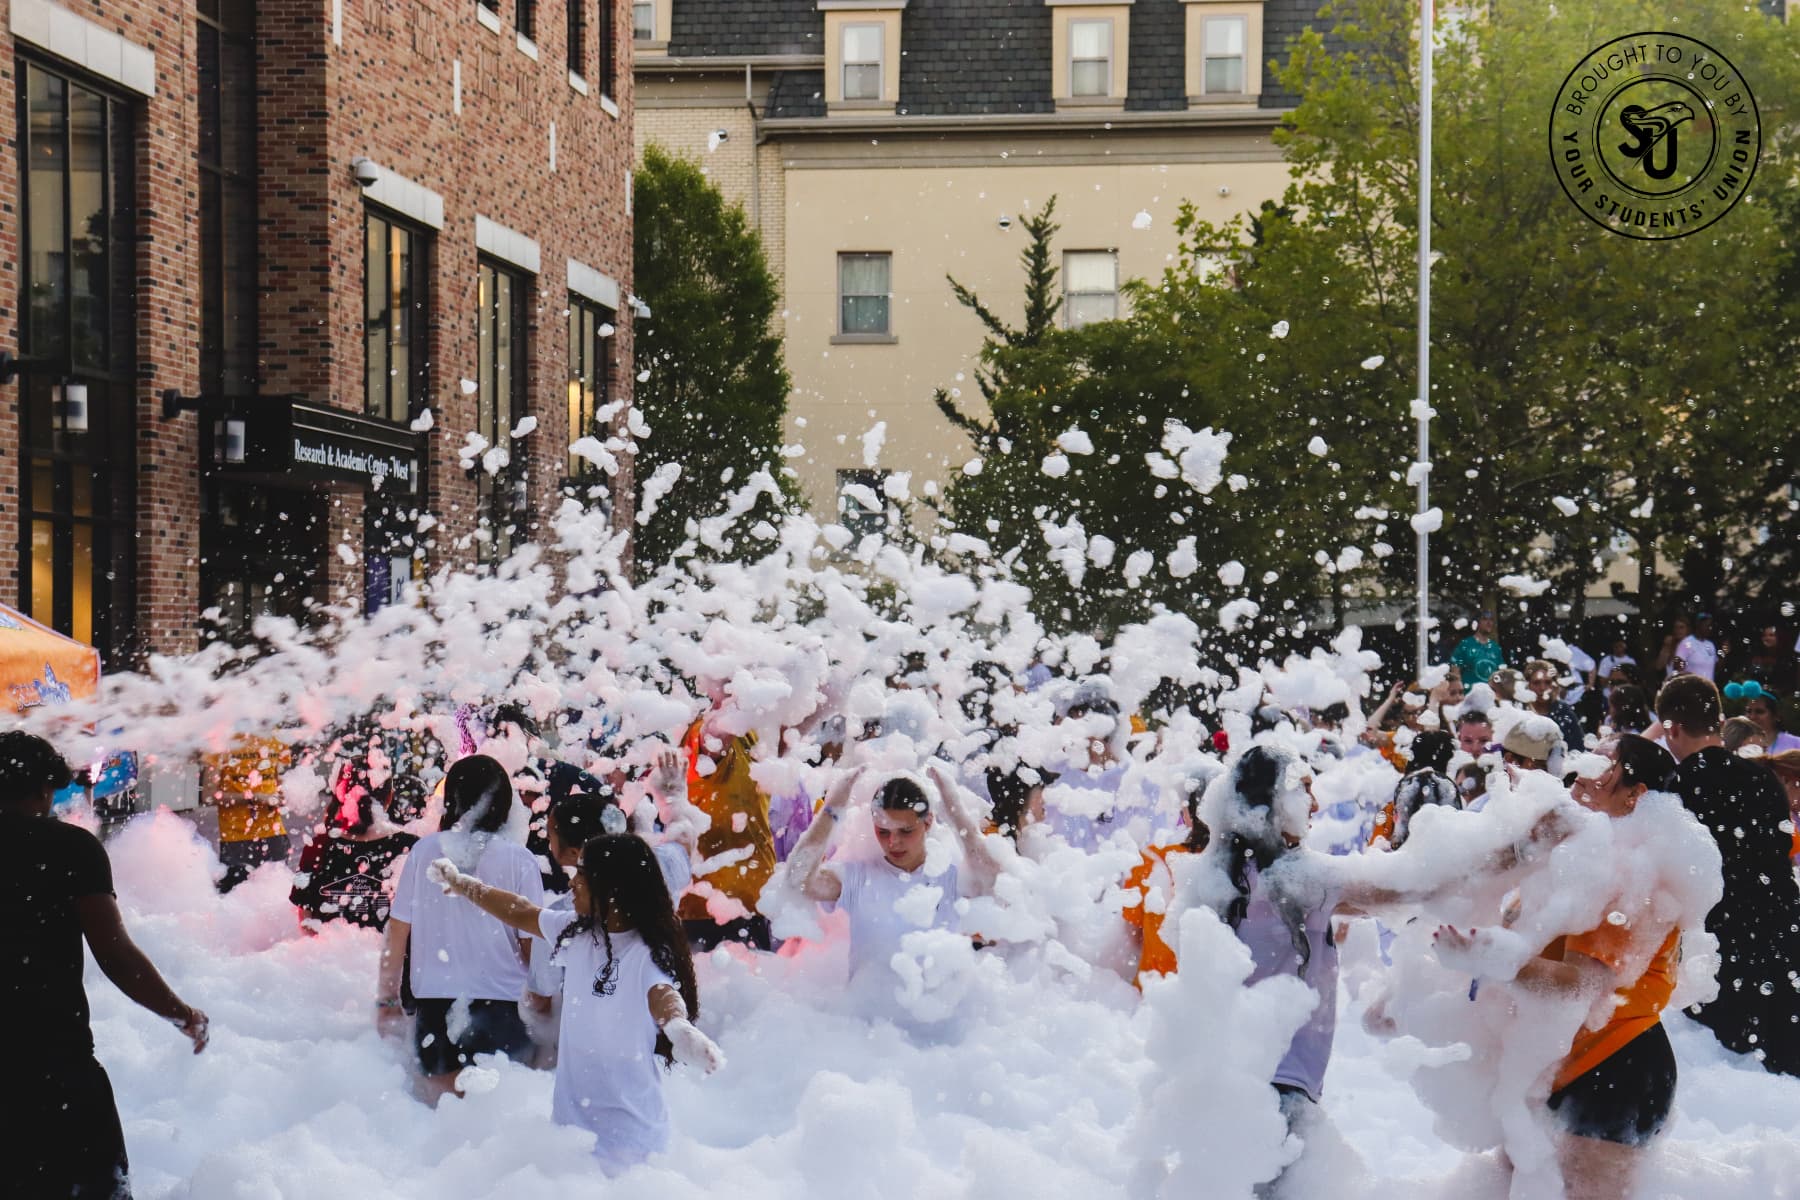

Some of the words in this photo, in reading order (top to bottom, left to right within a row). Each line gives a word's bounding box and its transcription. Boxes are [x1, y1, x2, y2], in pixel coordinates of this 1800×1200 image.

[294, 438, 326, 465] Research
[327, 445, 336, 467] &
[335, 447, 367, 473] Academic
[367, 453, 389, 477] Centre
[390, 455, 408, 480] West
